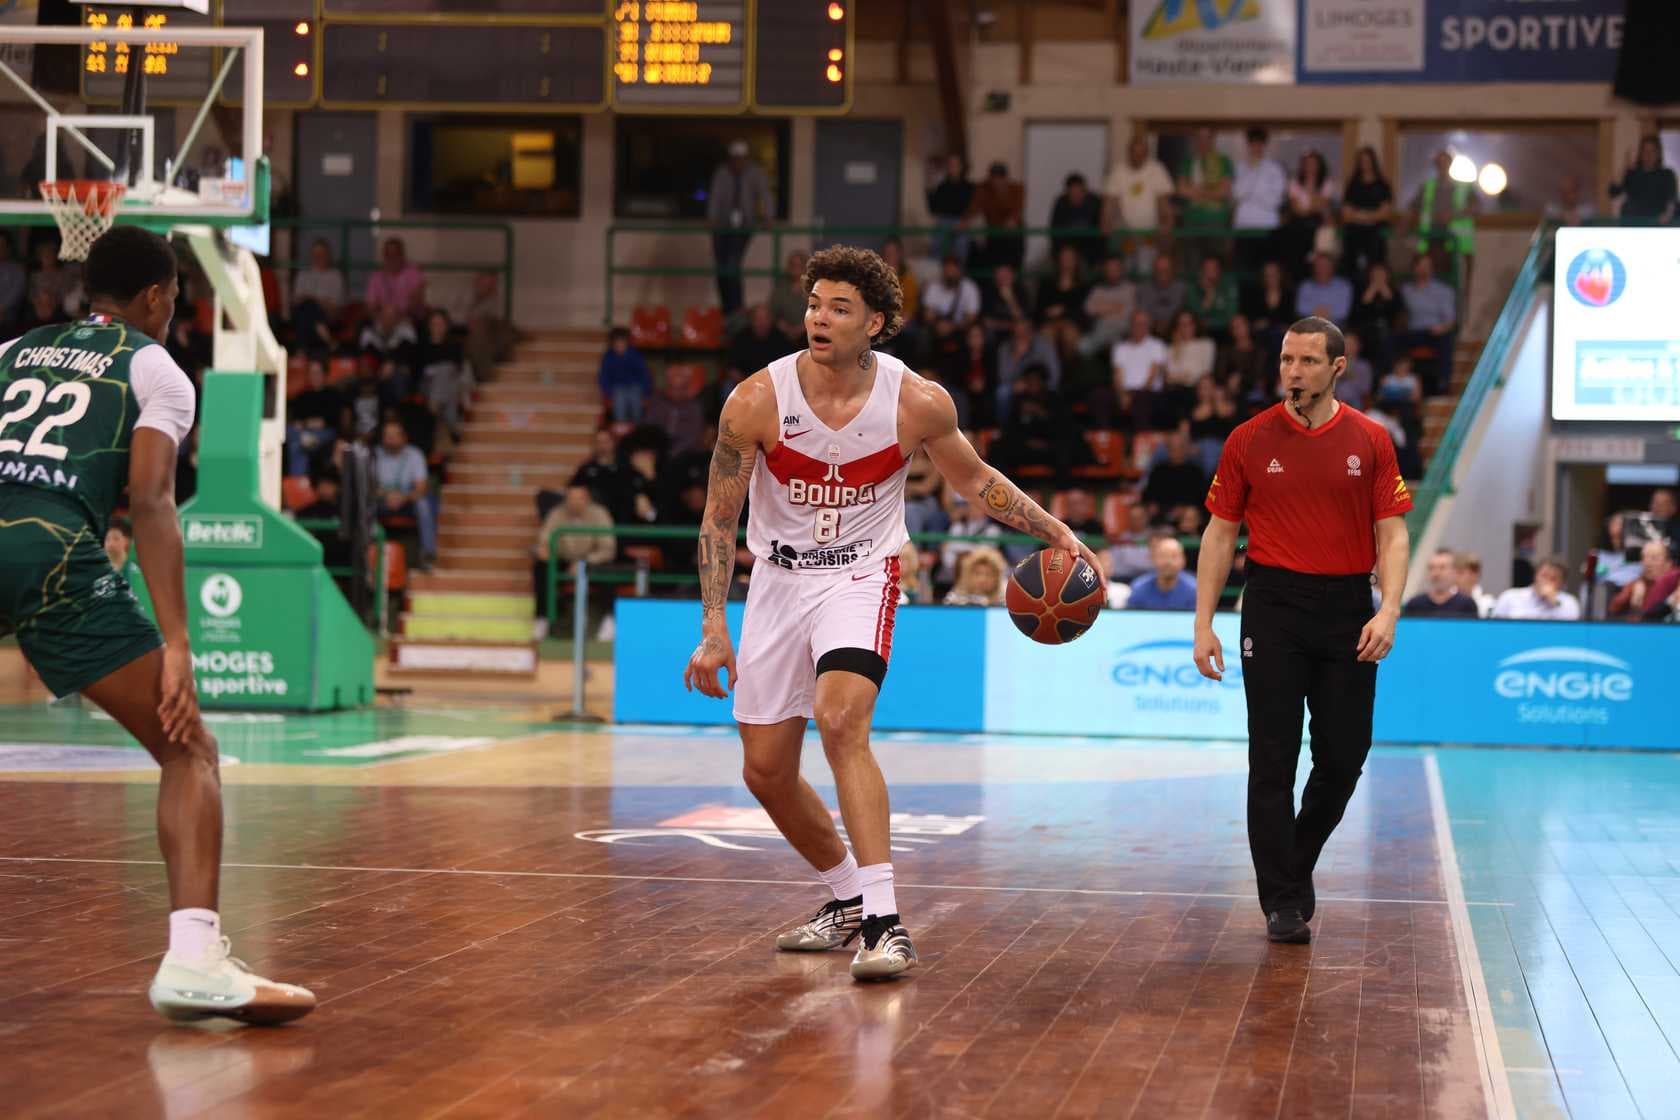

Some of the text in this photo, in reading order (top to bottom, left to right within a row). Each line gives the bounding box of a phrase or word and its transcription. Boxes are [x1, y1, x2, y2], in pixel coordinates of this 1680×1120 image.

[1440, 14, 1626, 50] SPORTIVE
[14, 347, 114, 378] CHRISTMAS
[0, 378, 91, 461] 22
[783, 415, 800, 425] AIN
[0, 461, 79, 490] MAN
[789, 478, 876, 508] BOURG
[186, 520, 256, 543] Betclic
[813, 507, 841, 544] 8
[190, 651, 275, 674] MOGES
[202, 674, 288, 698] sportive
[1517, 702, 1609, 725] Solutions
